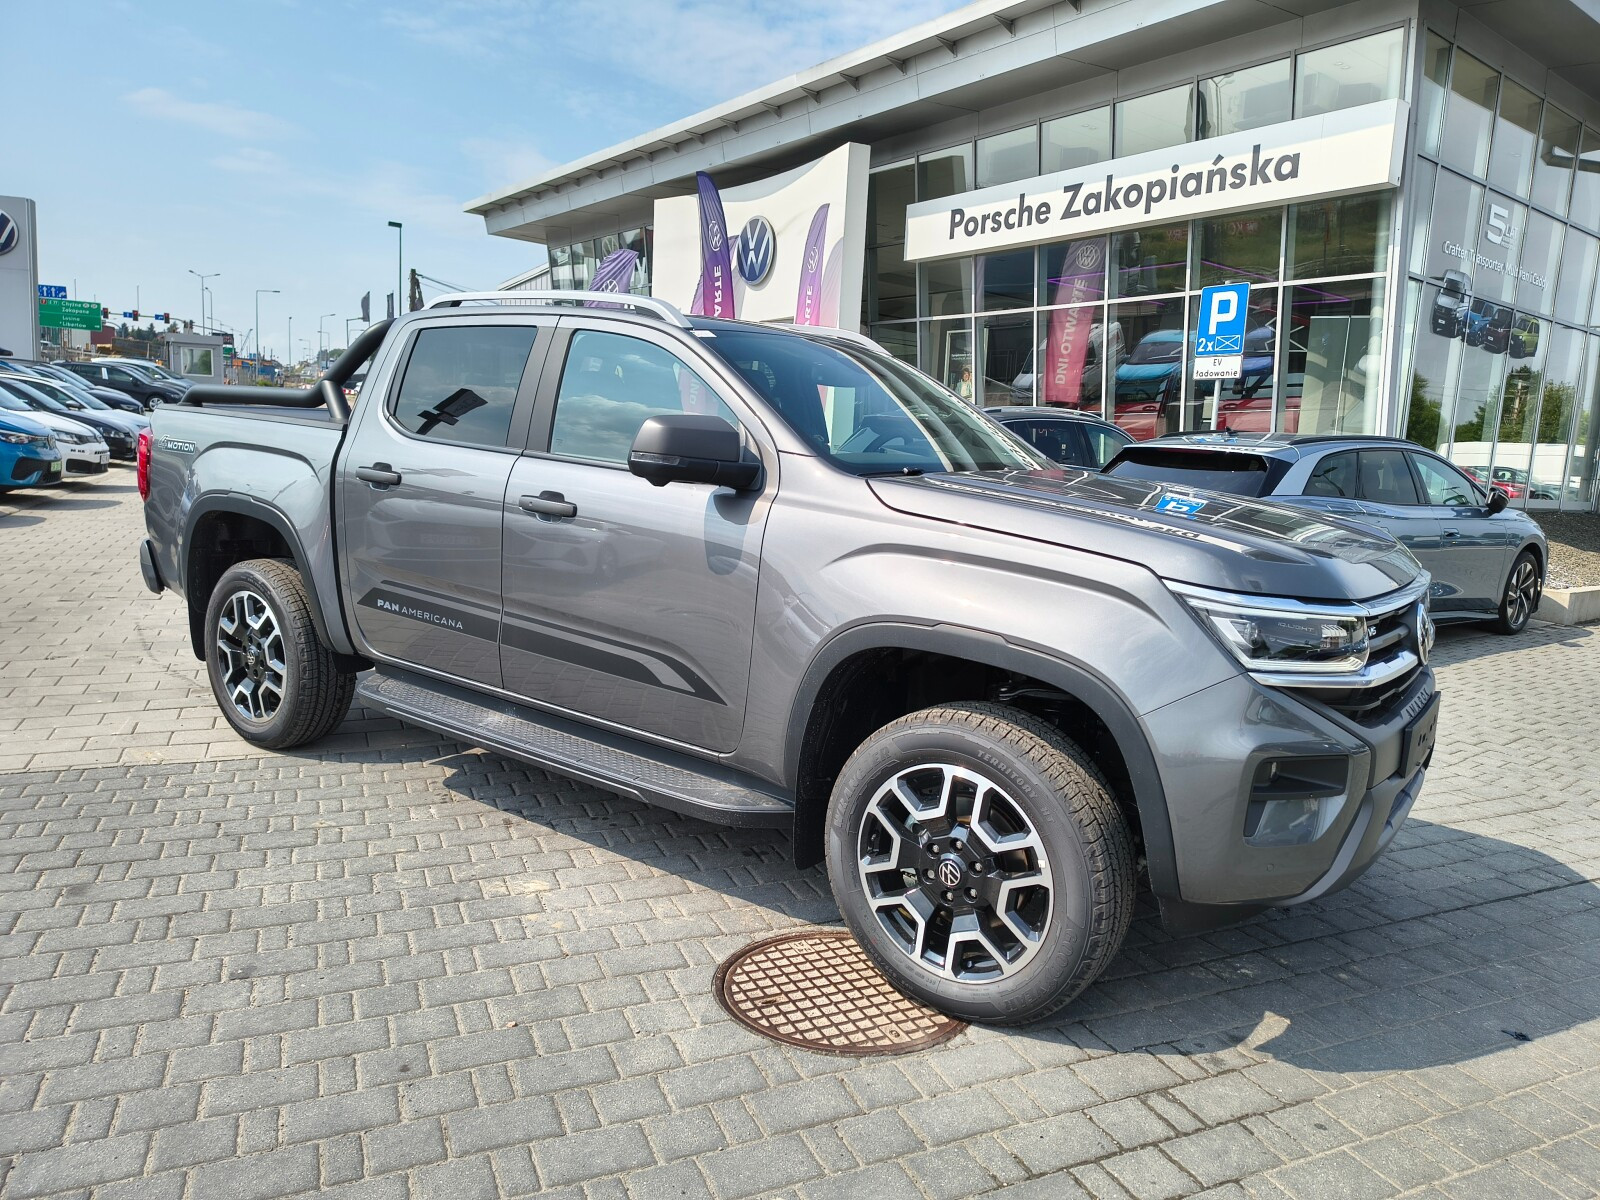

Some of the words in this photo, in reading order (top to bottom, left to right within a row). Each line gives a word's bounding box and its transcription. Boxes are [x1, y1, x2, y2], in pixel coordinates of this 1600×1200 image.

[949, 193, 1051, 240] Porsche
[1060, 143, 1301, 220] Zakopiańska
[1487, 203, 1508, 245] 5
[1061, 278, 1088, 356] OTWARTE
[1208, 290, 1238, 335] P
[1197, 337, 1214, 352] 2x
[1055, 358, 1070, 385] DNI
[1195, 369, 1238, 378] ładowanie
[1213, 358, 1223, 367] EV
[158, 434, 196, 455] 4MOTION
[377, 599, 399, 613] PAN
[401, 606, 464, 630] AMERICANA
[1405, 687, 1430, 719] AMAROK
[977, 749, 1038, 799] TERRITORY
